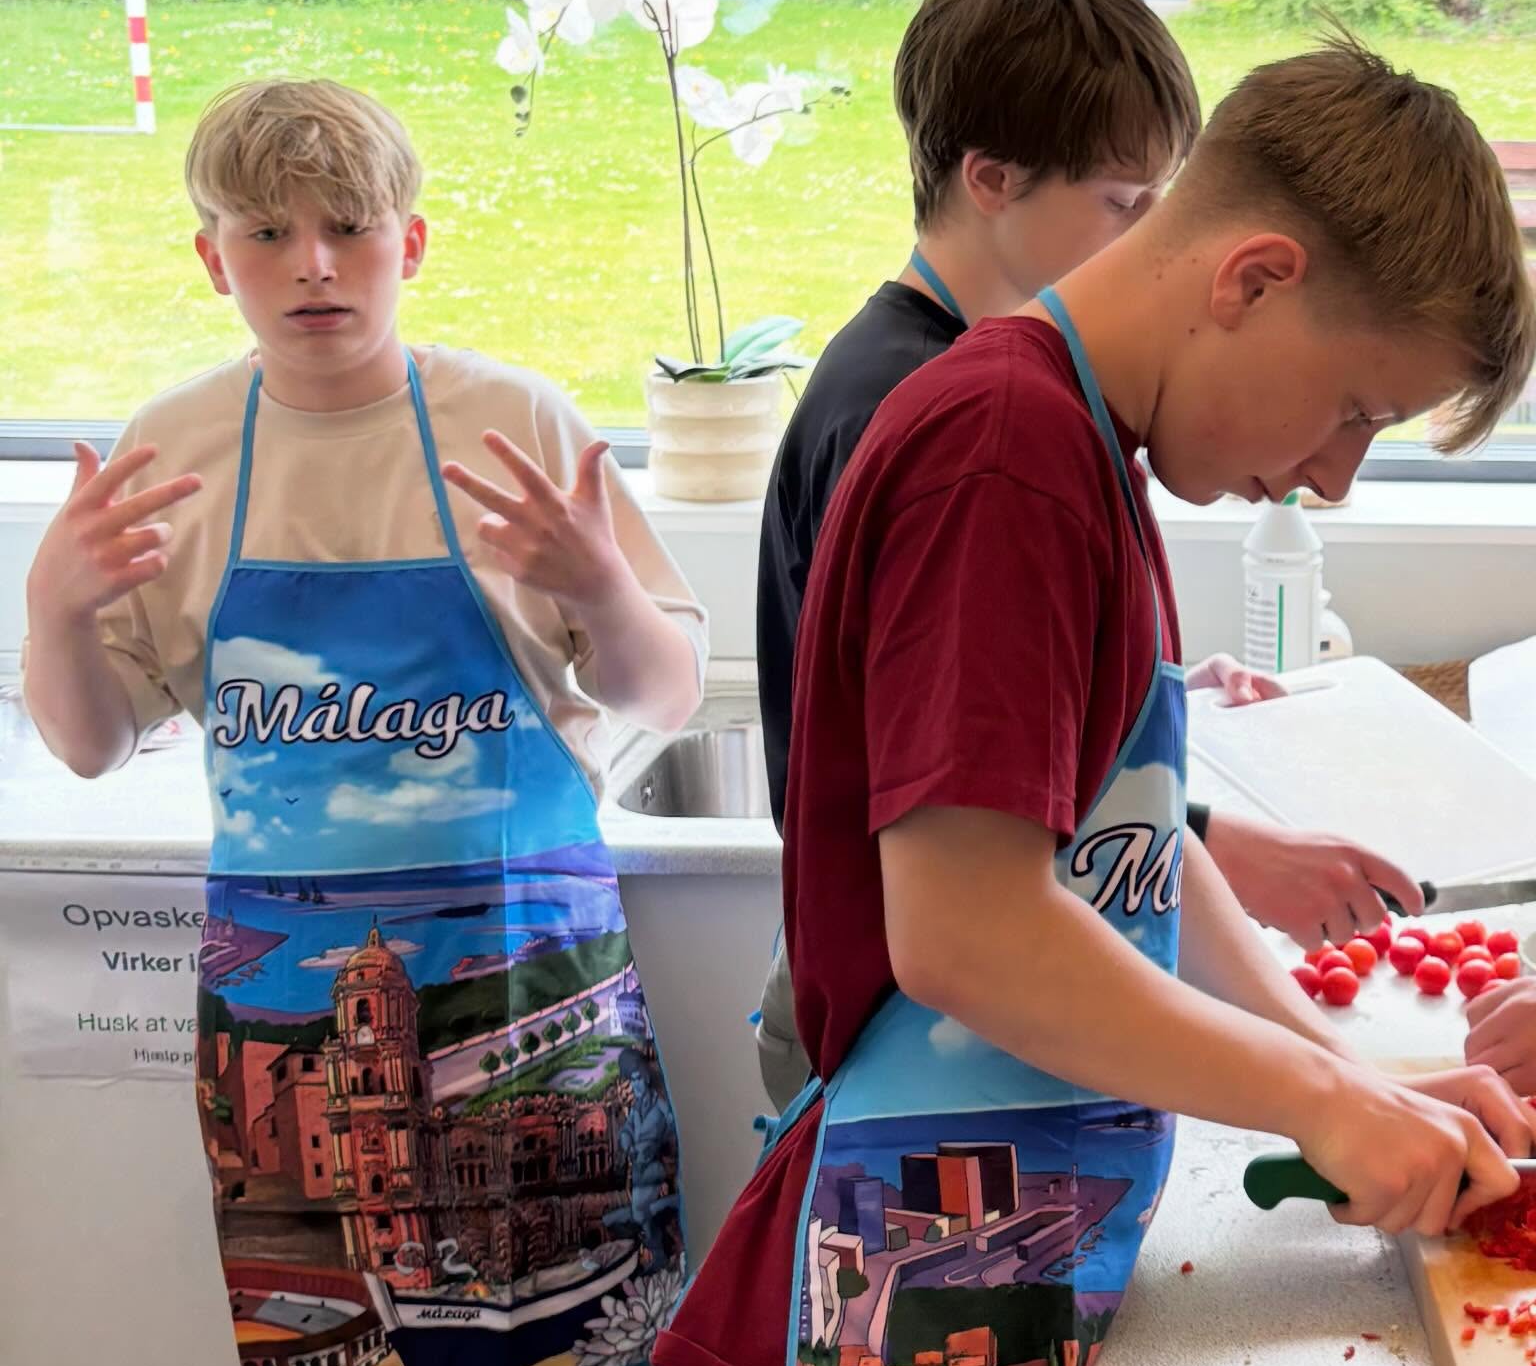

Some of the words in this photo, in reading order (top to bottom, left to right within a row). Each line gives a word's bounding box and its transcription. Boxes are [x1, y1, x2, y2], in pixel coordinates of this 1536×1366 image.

[213, 678, 516, 759] Málaga
[101, 951, 183, 972] Virker
[77, 1013, 139, 1032] Husk
[145, 1015, 168, 1032] at
